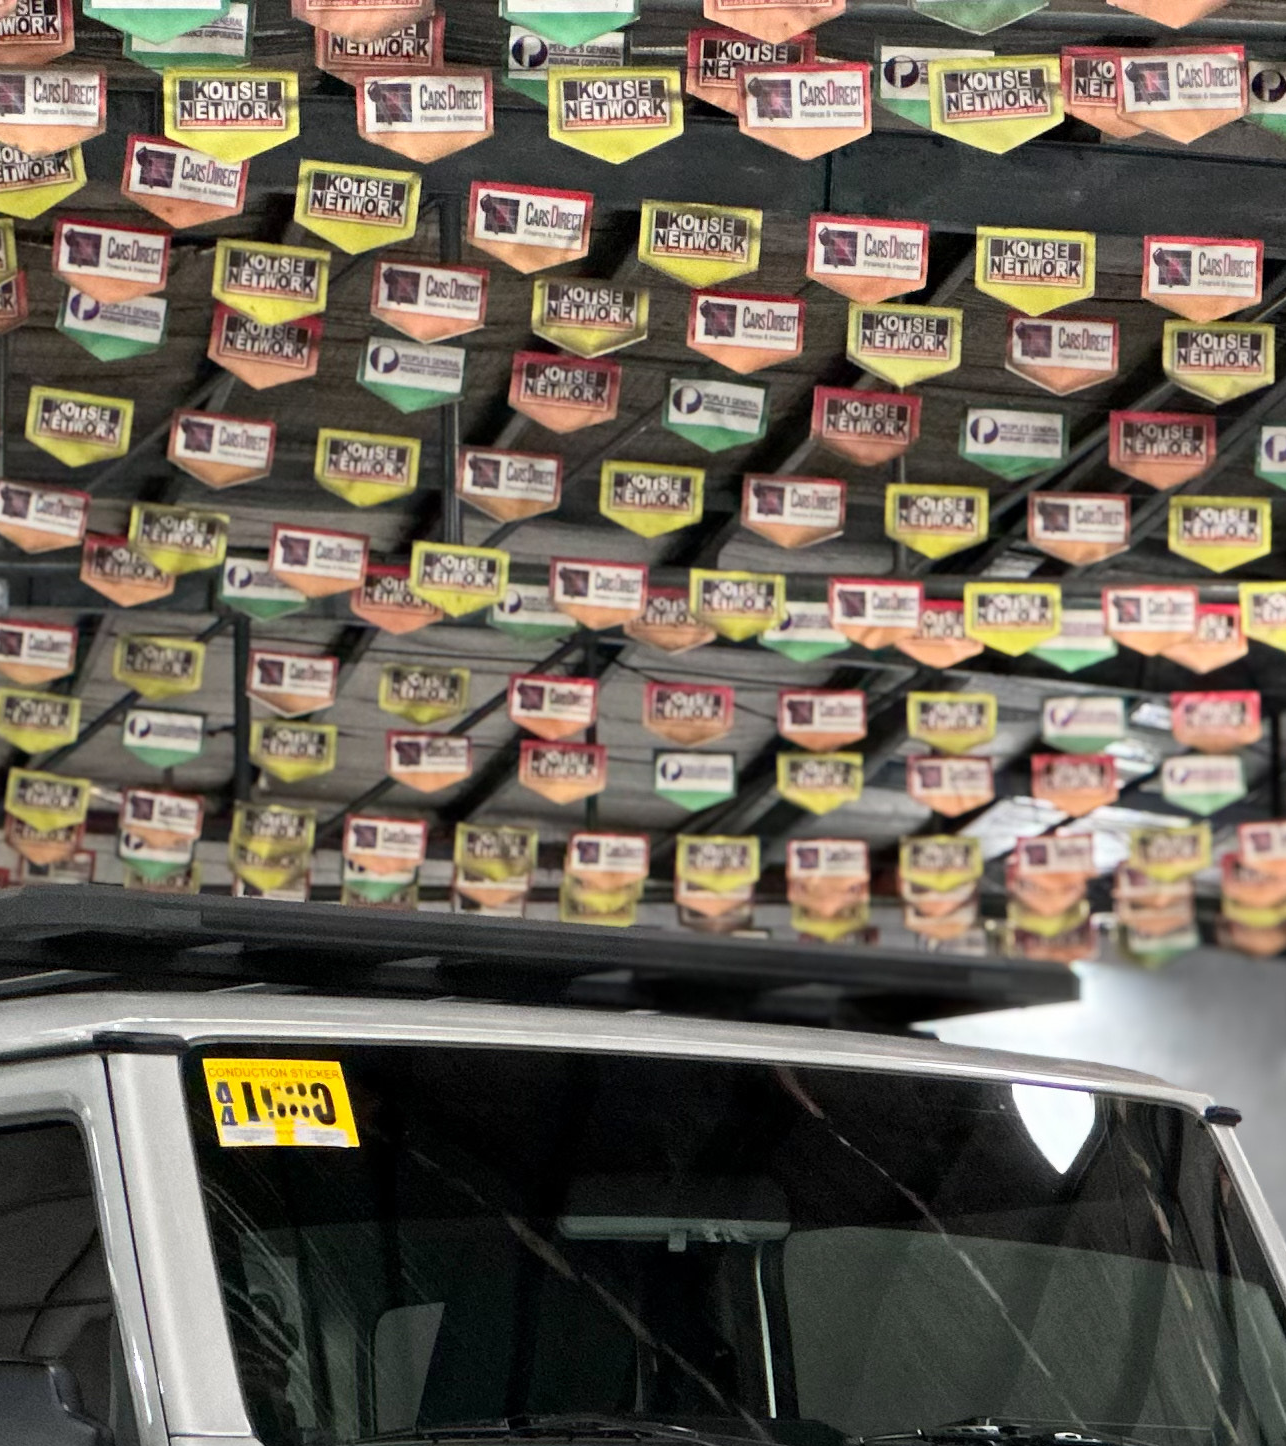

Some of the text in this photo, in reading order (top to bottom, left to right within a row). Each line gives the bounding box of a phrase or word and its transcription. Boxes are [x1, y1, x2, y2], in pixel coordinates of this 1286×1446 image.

[717, 41, 787, 62] KOTSE
[195, 82, 268, 99] KOTSE
[579, 81, 651, 100] KOTSE
[960, 70, 1031, 92] KOTSE
[564, 101, 666, 118] NETWORK
[947, 88, 1045, 112] NETWORK
[180, 101, 282, 120] NETWORK
[327, 174, 393, 198] KOTSE
[312, 190, 404, 218] NETWORK
[669, 212, 735, 232] KOTSE
[655, 230, 744, 252] NETWORK
[1004, 240, 1068, 259] KOTSE
[243, 252, 305, 273] KOTSE
[991, 260, 1080, 278] NETWORK
[561, 286, 623, 304] KOTSE
[547, 301, 633, 323] NETWORK
[875, 315, 937, 332] KOTSE
[862, 332, 946, 350] NETWORK
[1190, 333, 1249, 349] KOTSE
[1177, 351, 1261, 366] NETWORK
[208, 1067, 340, 1080] CONDUCTION STICKER
